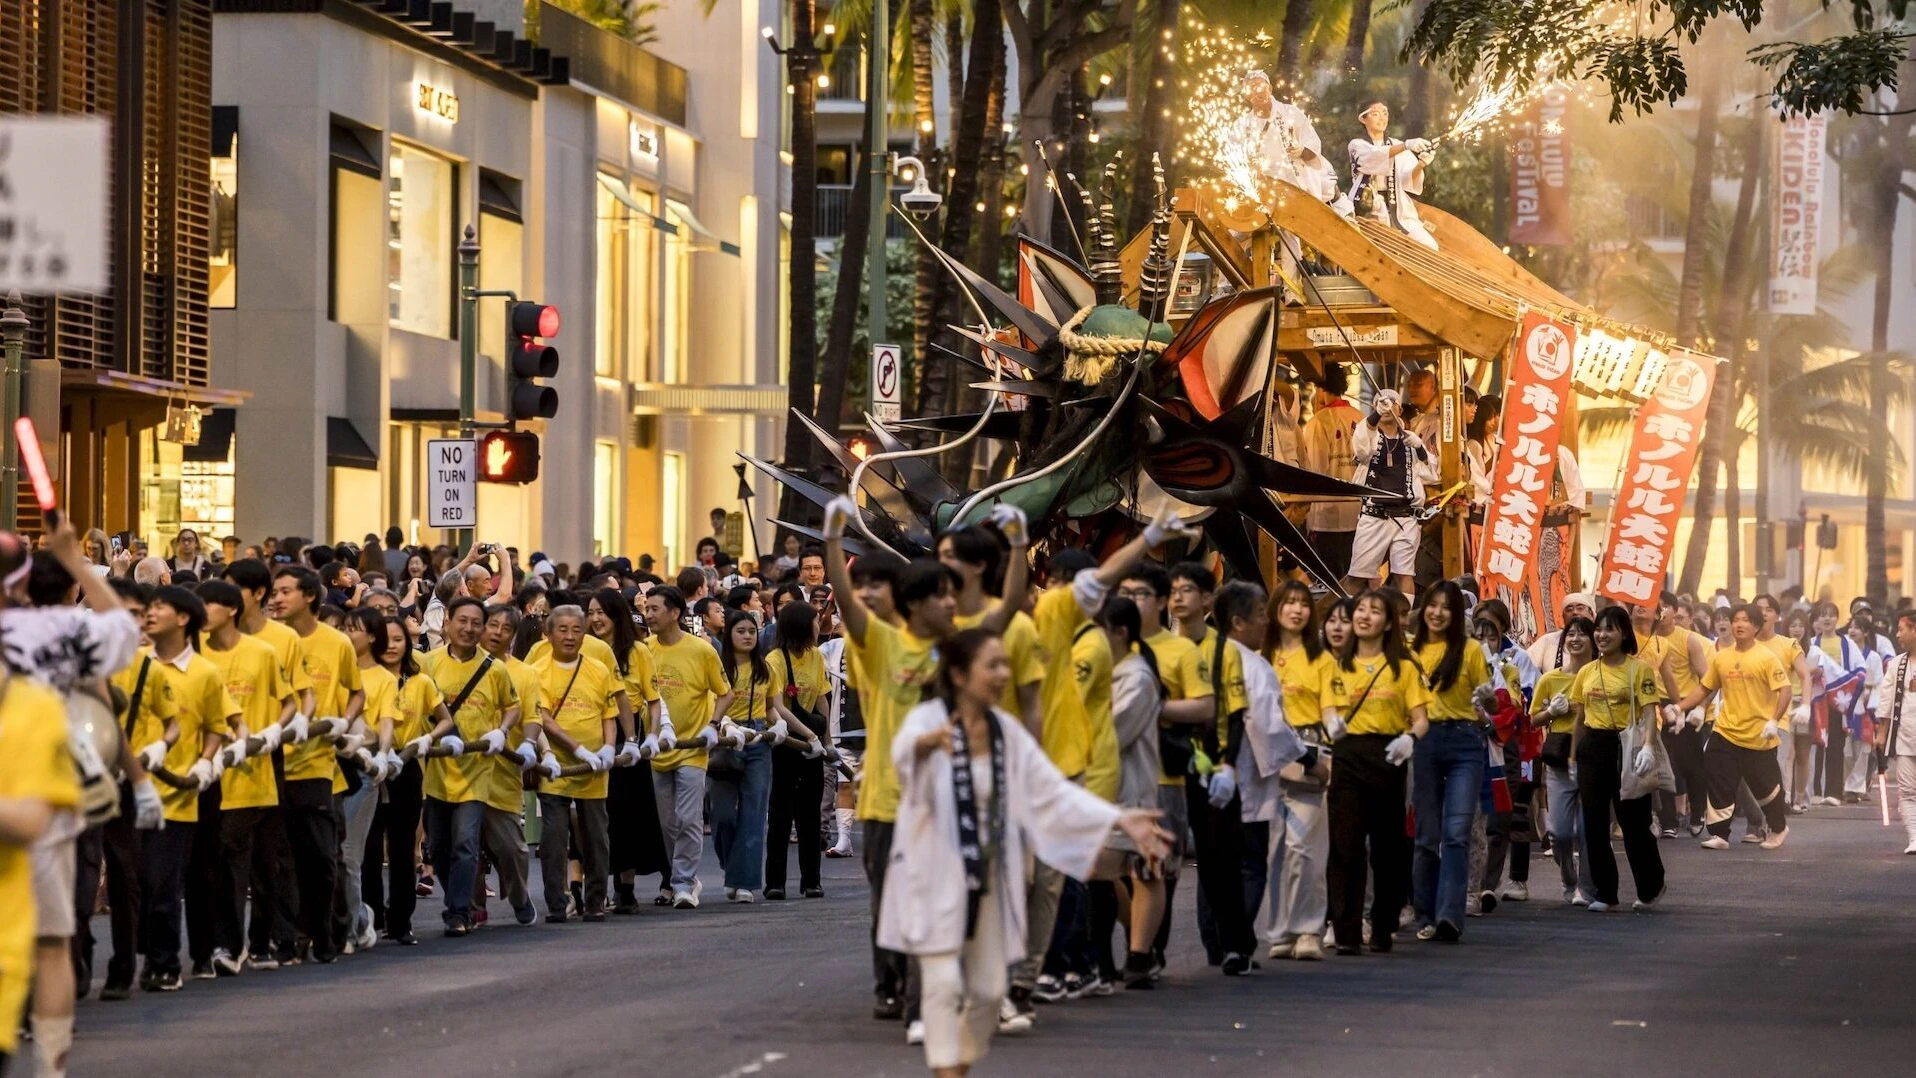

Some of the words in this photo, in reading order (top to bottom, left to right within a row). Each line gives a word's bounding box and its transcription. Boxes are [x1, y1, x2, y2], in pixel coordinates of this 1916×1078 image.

[1806, 115, 1824, 194] Honolulu
[1802, 201, 1818, 279] Rainbow
[438, 470, 466, 483] TURN
[441, 446, 463, 464] NO
[444, 488, 460, 501] ON
[1488, 383, 1560, 583] ホノルル大蛇山
[1605, 413, 1694, 601] ホノルル大蛇山
[442, 507, 463, 520] RED
